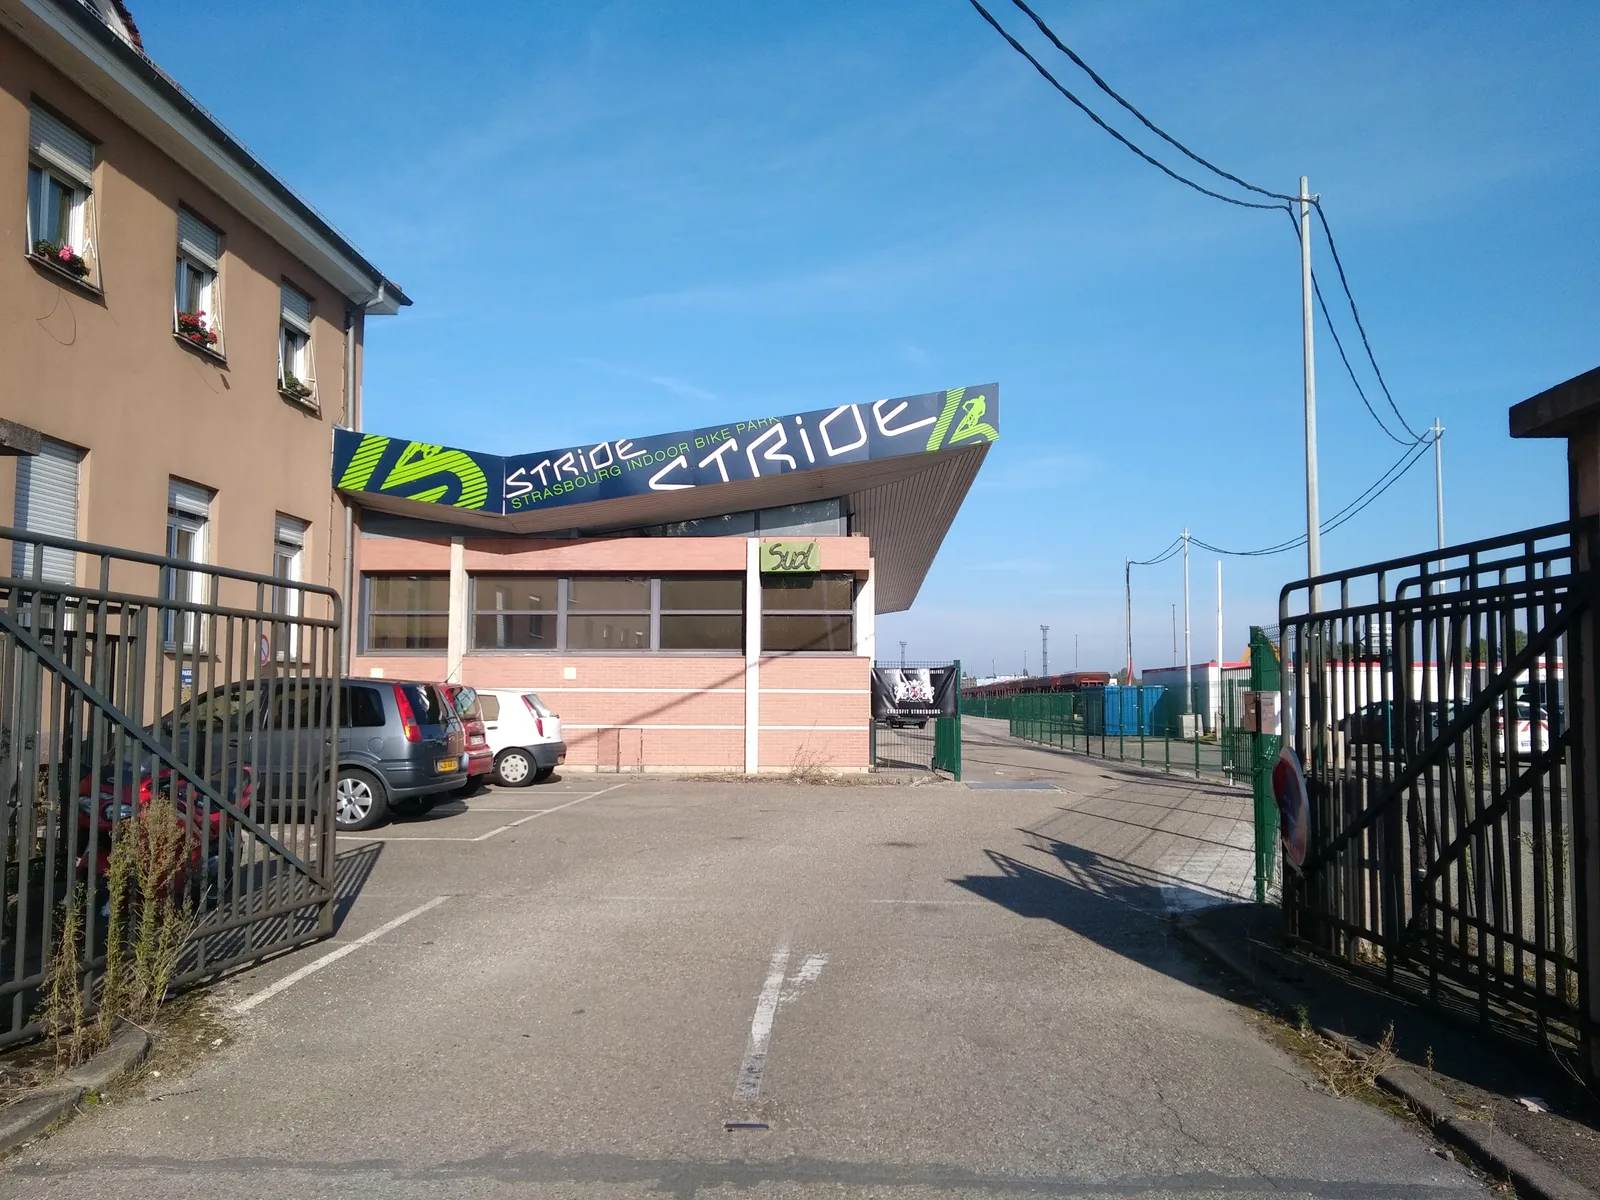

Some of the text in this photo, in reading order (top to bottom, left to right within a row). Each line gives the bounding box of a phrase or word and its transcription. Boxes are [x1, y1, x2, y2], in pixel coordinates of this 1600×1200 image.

[511, 467, 622, 509] STRASBOURG
[626, 442, 690, 472] INDOOR
[694, 428, 731, 449] BIKE
[769, 543, 814, 570] Sud
